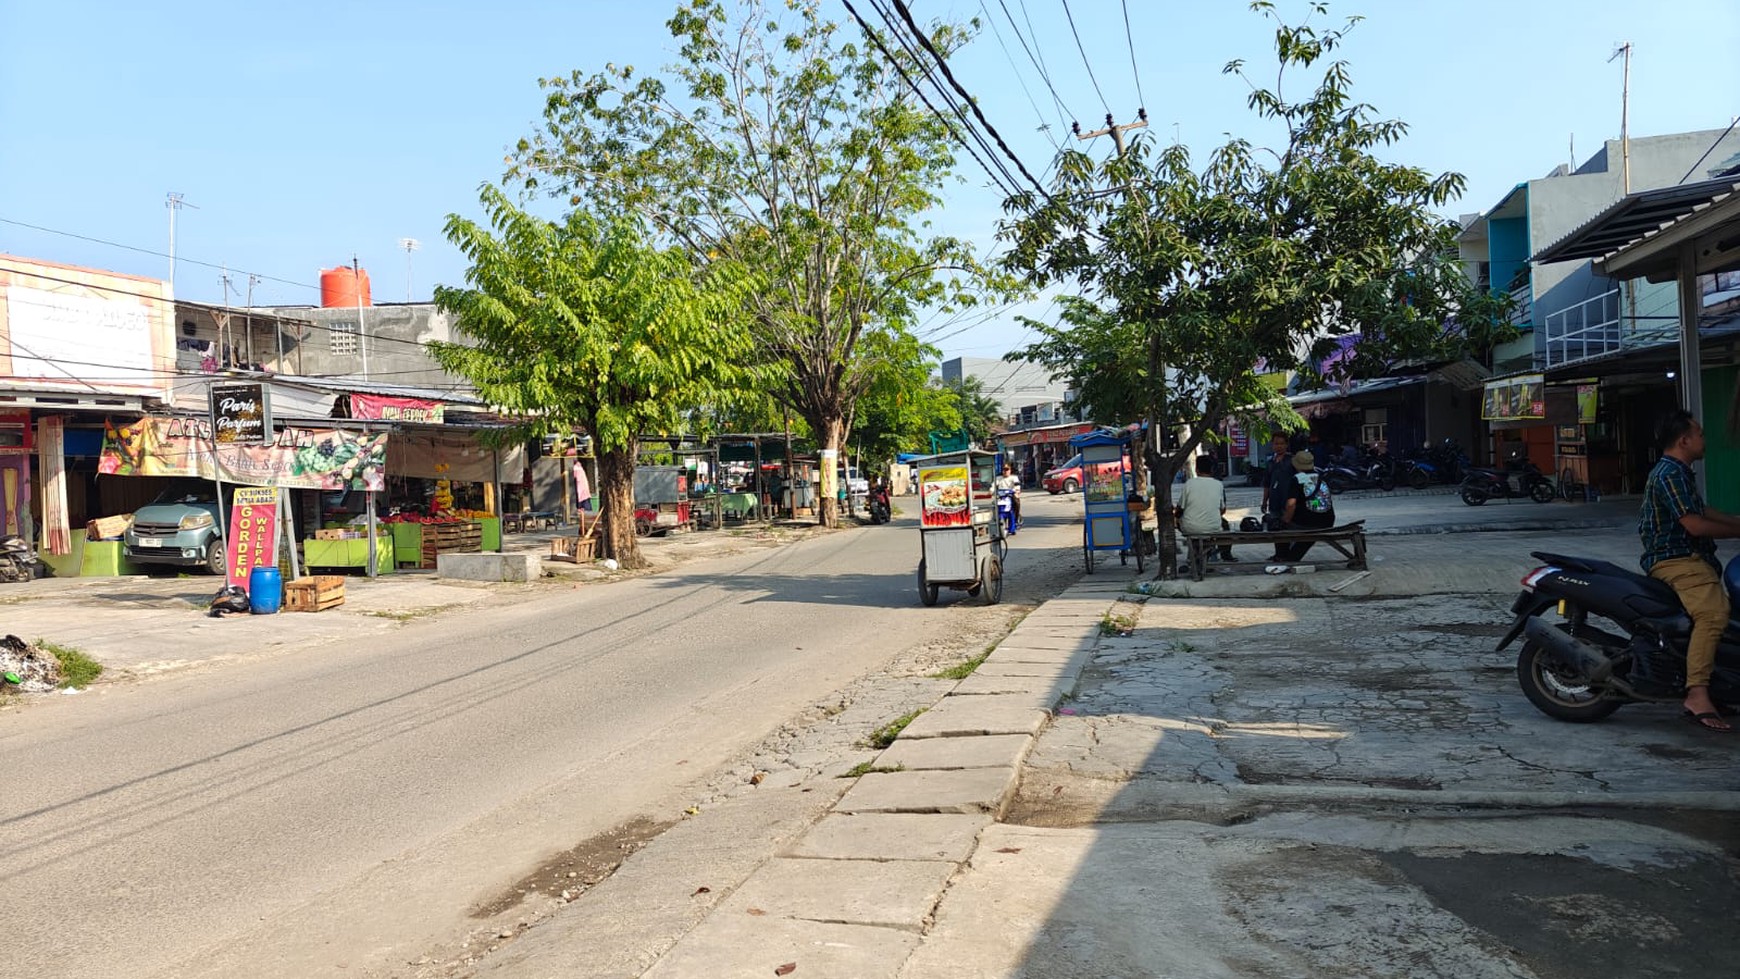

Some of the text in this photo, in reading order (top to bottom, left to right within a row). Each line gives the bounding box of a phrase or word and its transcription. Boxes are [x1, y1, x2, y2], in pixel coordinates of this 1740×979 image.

[220, 397, 256, 414] Paris
[217, 417, 261, 433] Parfum
[235, 507, 253, 577] GORDEN
[254, 517, 267, 567] WALLPA
